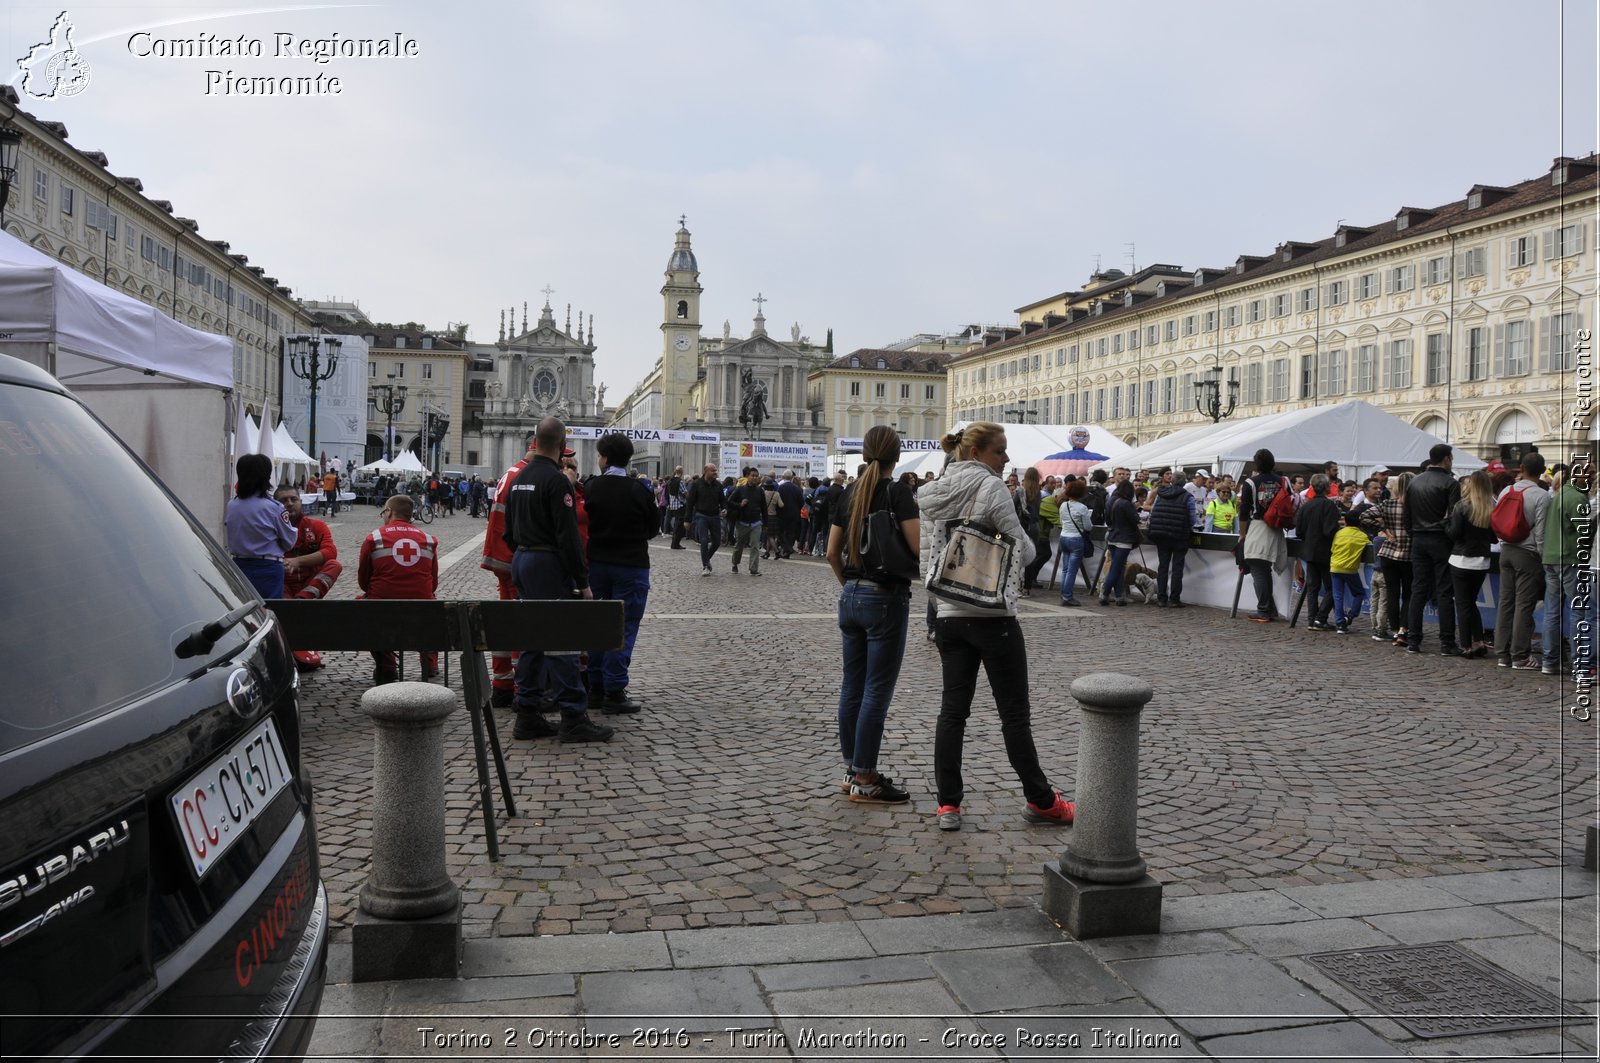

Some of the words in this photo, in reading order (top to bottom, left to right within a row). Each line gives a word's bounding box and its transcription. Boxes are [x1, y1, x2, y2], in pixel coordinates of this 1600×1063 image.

[754, 445, 773, 453] TURIN
[773, 446, 809, 455] MARATHON
[900, 440, 943, 450] ARTENZ
[0, 820, 130, 911] SUBARU
